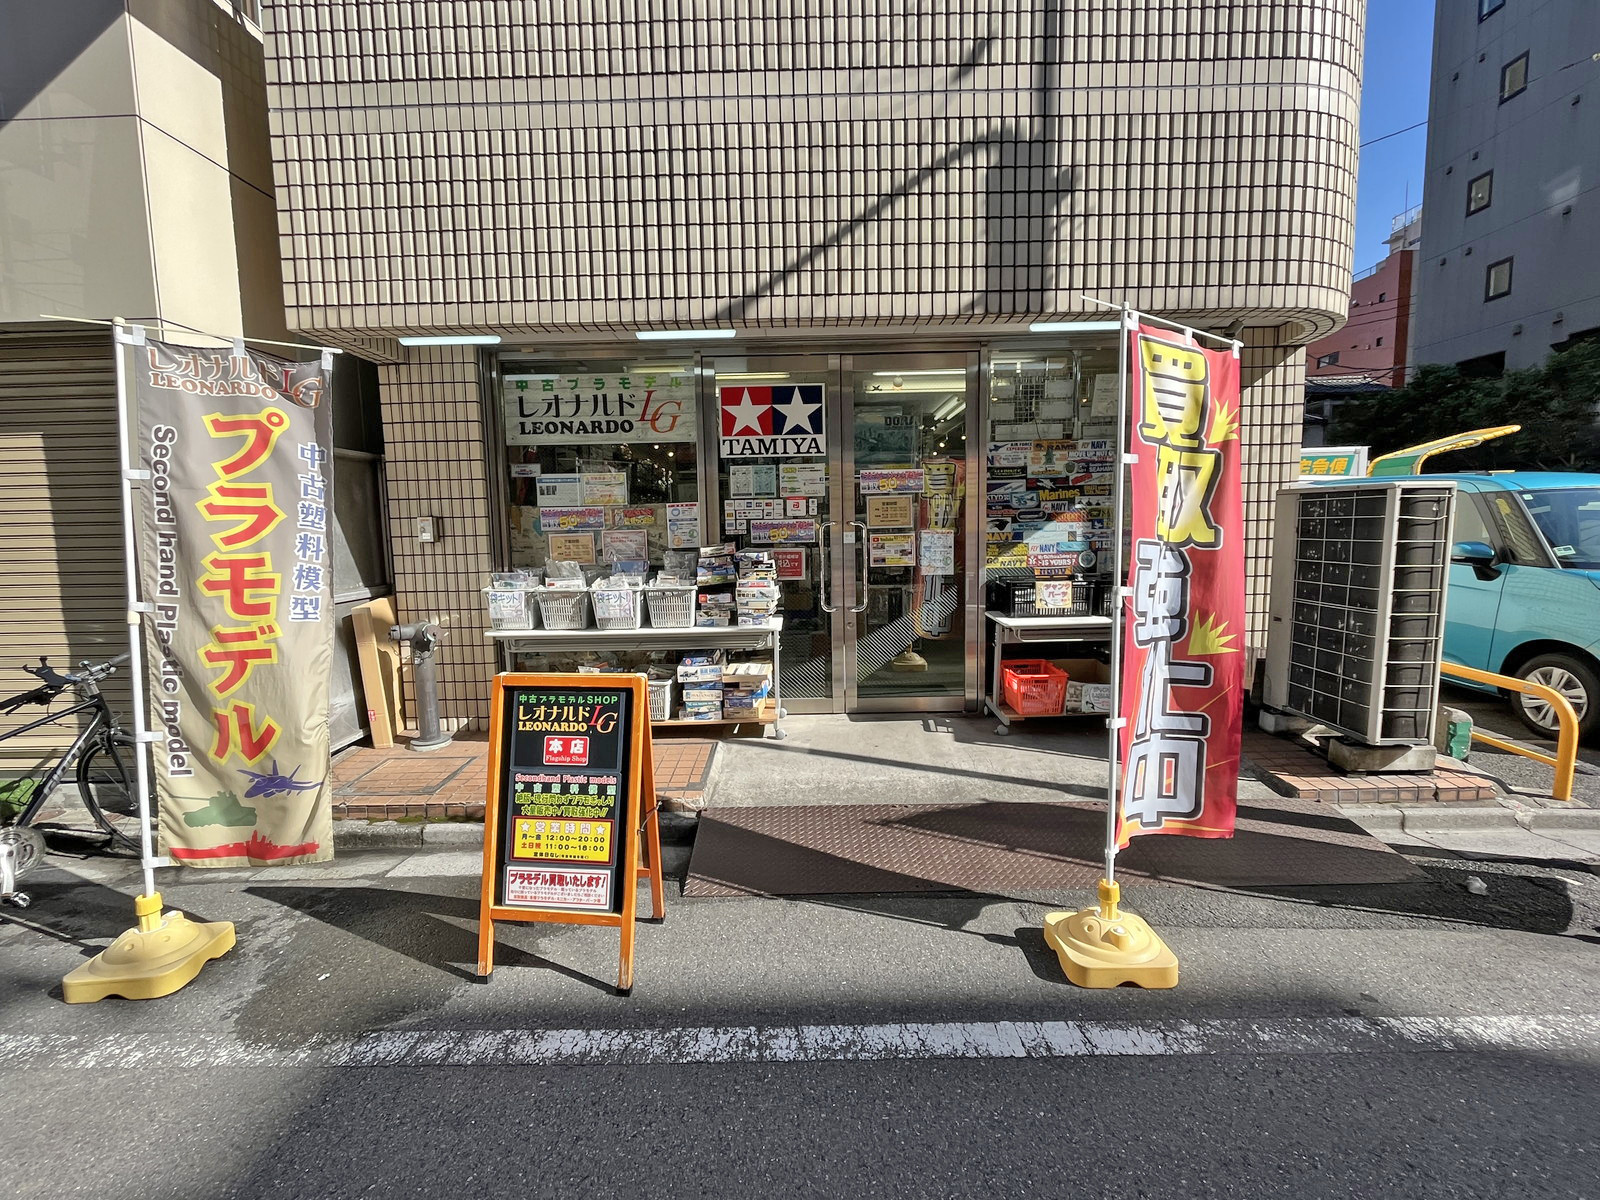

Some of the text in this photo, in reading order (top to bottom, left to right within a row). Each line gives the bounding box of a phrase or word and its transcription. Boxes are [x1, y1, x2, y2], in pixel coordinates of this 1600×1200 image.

[148, 347, 279, 386] レオナルド
[150, 371, 278, 401] LEONARDO
[515, 377, 683, 392] 中古プラモデル
[518, 392, 636, 418] レオナルド
[519, 419, 634, 435] LEONARDO
[722, 437, 825, 456] TAMIYA
[1091, 441, 1107, 449] NAVY
[1300, 457, 1349, 475] 宅急便
[1039, 489, 1081, 501] Marines
[1051, 502, 1067, 512] NAVY
[288, 441, 328, 623] 中古塑料模型
[1039, 543, 1056, 553] NAVY
[986, 557, 1025, 567] GO NAVY
[195, 406, 291, 767] プラモデル
[1123, 333, 1224, 829] 買取強化中
[151, 424, 194, 778] Second hand Plastic model
[518, 705, 591, 721] レオナルド
[518, 721, 588, 732] LEONARDO
[548, 738, 585, 754] 本店
[546, 755, 571, 763] Flagship
[515, 773, 617, 785] Secondhand Plastic models
